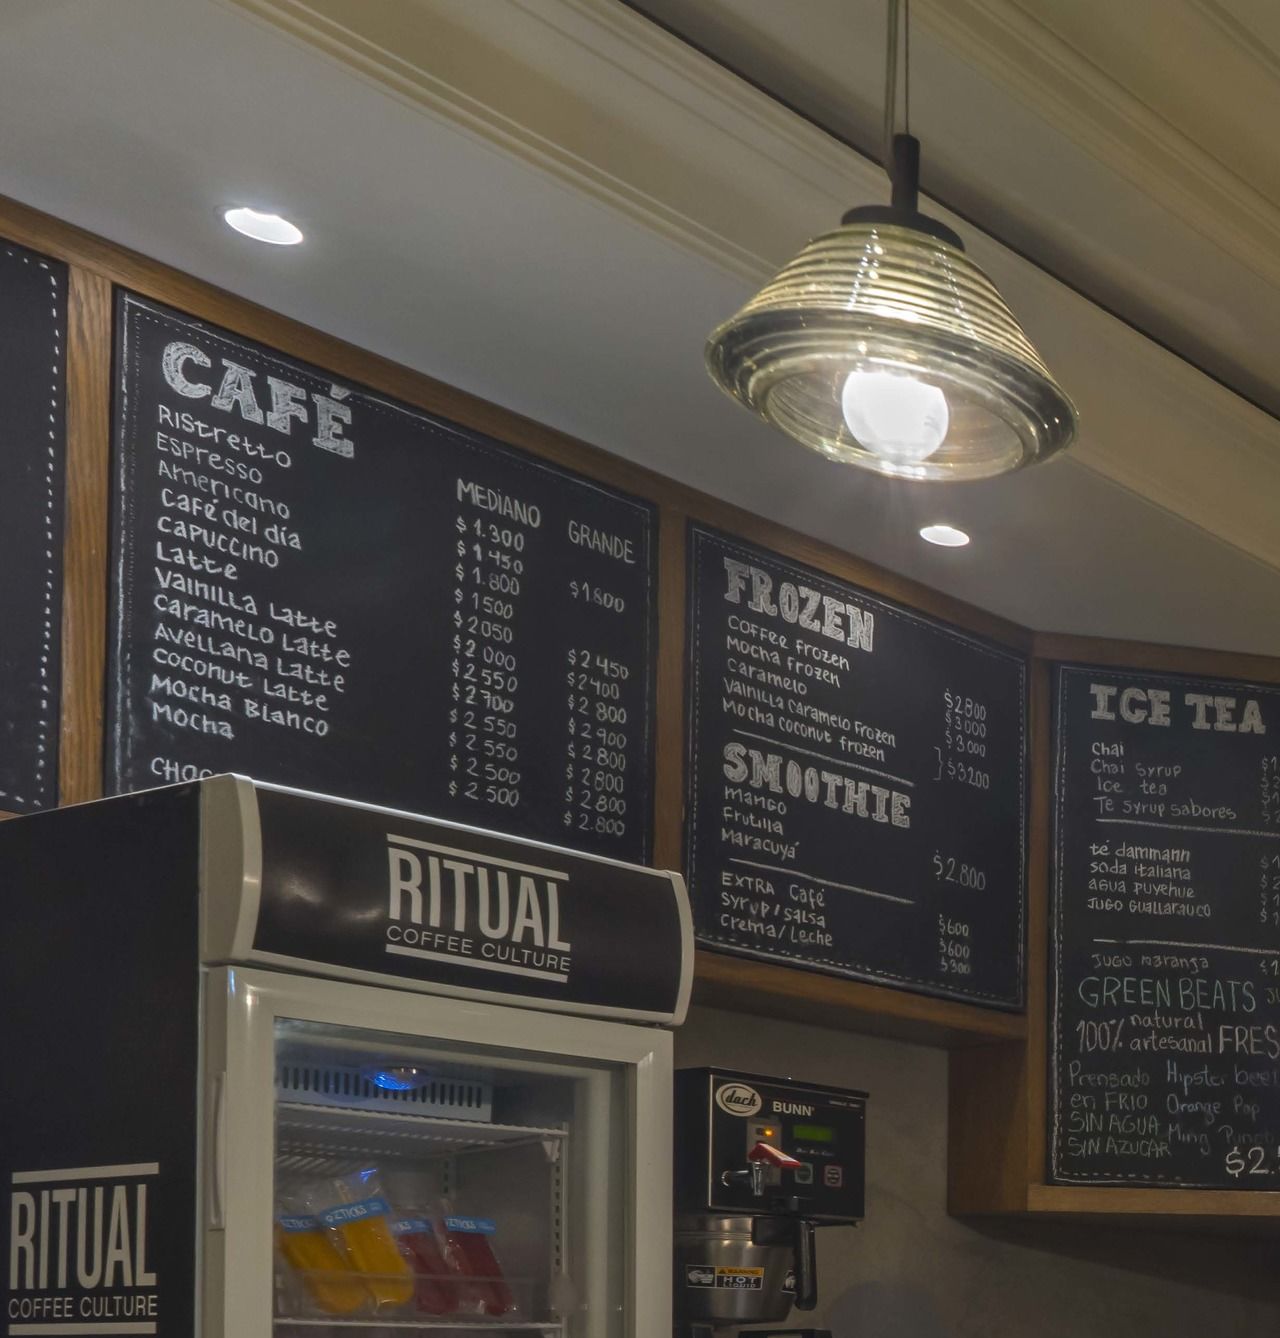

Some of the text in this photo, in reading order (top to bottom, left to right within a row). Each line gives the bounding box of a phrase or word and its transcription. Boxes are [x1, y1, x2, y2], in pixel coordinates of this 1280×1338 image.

[162, 341, 354, 458] CAFÉ
[159, 460, 290, 519] Americano
[457, 478, 541, 528] MEDIANO
[223, 509, 257, 535] del
[568, 520, 635, 564] GRANDE
[156, 541, 238, 580] Latte
[270, 602, 337, 638] Latte
[724, 557, 874, 652] FROZEN
[282, 634, 350, 668] Latte
[727, 636, 781, 665] Mocha
[278, 658, 344, 693] Latte
[151, 674, 329, 737] Mocha Blanco
[264, 678, 329, 711] Latte
[1090, 683, 1267, 734] ICE TEA
[152, 702, 234, 739] Mocha
[1090, 759, 1124, 774] Chai
[1092, 741, 1124, 757] Chai
[724, 742, 912, 828] SMOOTHIE
[1140, 779, 1167, 795] tea
[1171, 799, 1237, 819] sabores
[722, 872, 775, 895] EXTRA
[1090, 859, 1192, 880] soda italiana
[387, 847, 571, 953] RITUAL
[386, 925, 572, 972] COFFEE CULTURE
[791, 924, 833, 947] Leche
[1078, 976, 1256, 1012] GREEN BEATS
[1130, 1010, 1203, 1031] natural
[1130, 1030, 1212, 1054] artesanal
[773, 1101, 813, 1117] BUNN
[10, 1184, 157, 1290] RITUAL
[8, 1295, 158, 1318] COFFEE CULTURE
